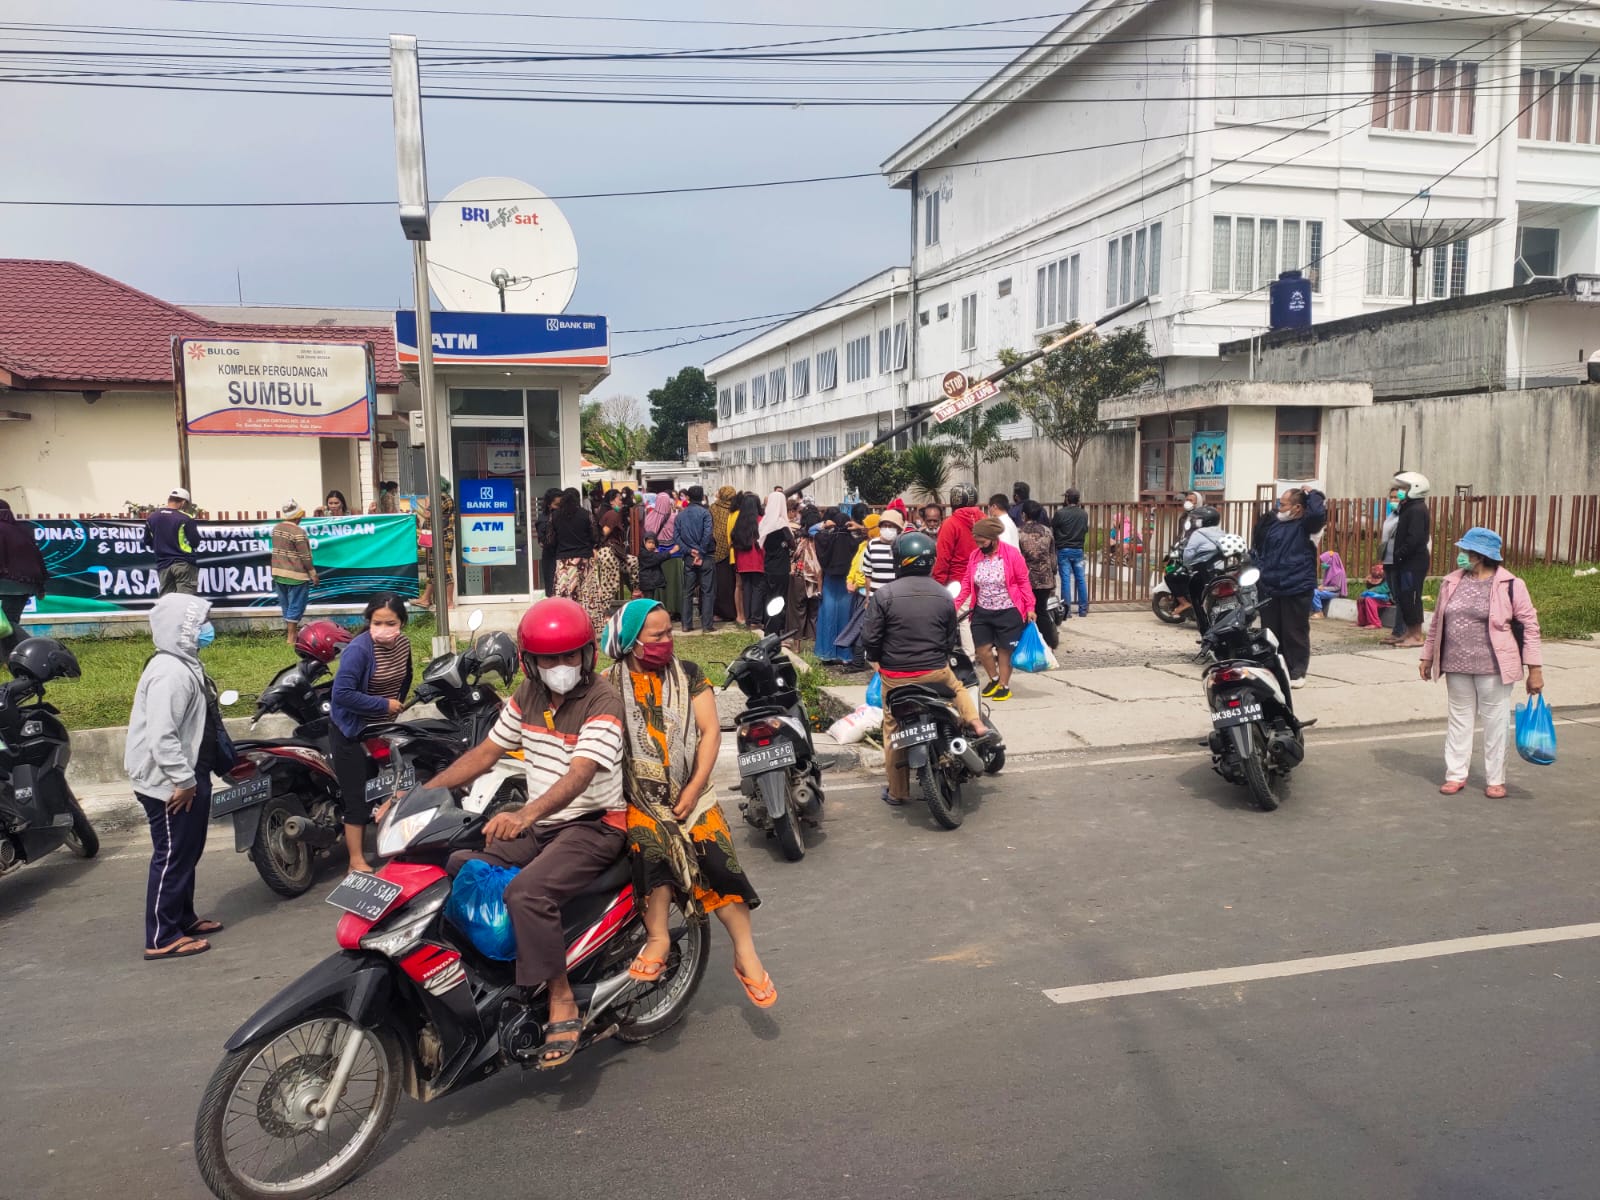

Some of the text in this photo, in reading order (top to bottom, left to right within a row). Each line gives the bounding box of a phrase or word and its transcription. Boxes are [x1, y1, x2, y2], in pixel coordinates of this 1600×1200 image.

[461, 206, 539, 225] BRI sat
[559, 321, 581, 329] BANK
[431, 333, 478, 350] ATM
[207, 347, 240, 356] BULOG
[218, 364, 328, 377] KOMPLEK PERGUDANGAN
[944, 374, 964, 394] STOP
[228, 380, 322, 407] SUMBUL
[466, 501, 508, 509] BANK BRI
[472, 521, 504, 532] ATM
[34, 527, 85, 541] DINAS
[98, 541, 110, 554] &
[373, 884, 397, 902] SAB
[422, 957, 455, 978] HONDA
